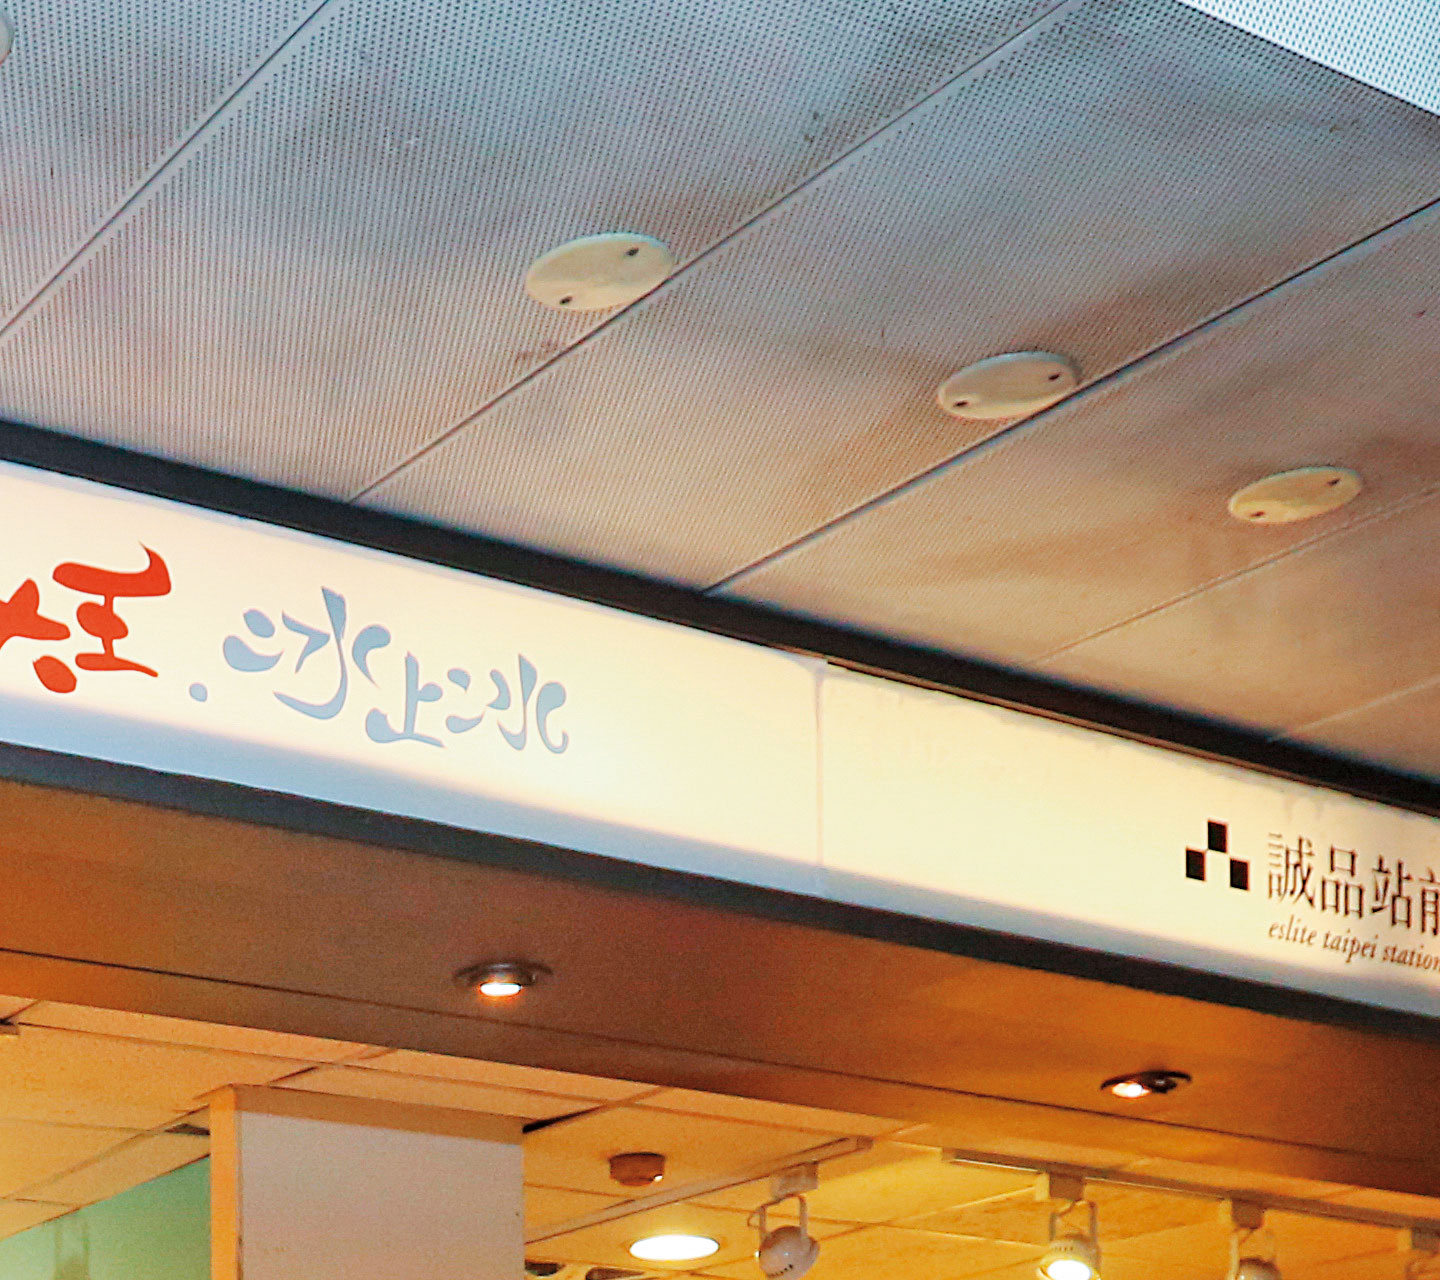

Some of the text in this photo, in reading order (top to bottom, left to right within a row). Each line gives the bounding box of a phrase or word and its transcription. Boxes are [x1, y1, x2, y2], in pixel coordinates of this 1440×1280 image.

[223, 588, 569, 755] 冰上冰
[1268, 915, 1316, 946] eslite
[1322, 930, 1378, 964] taipei
